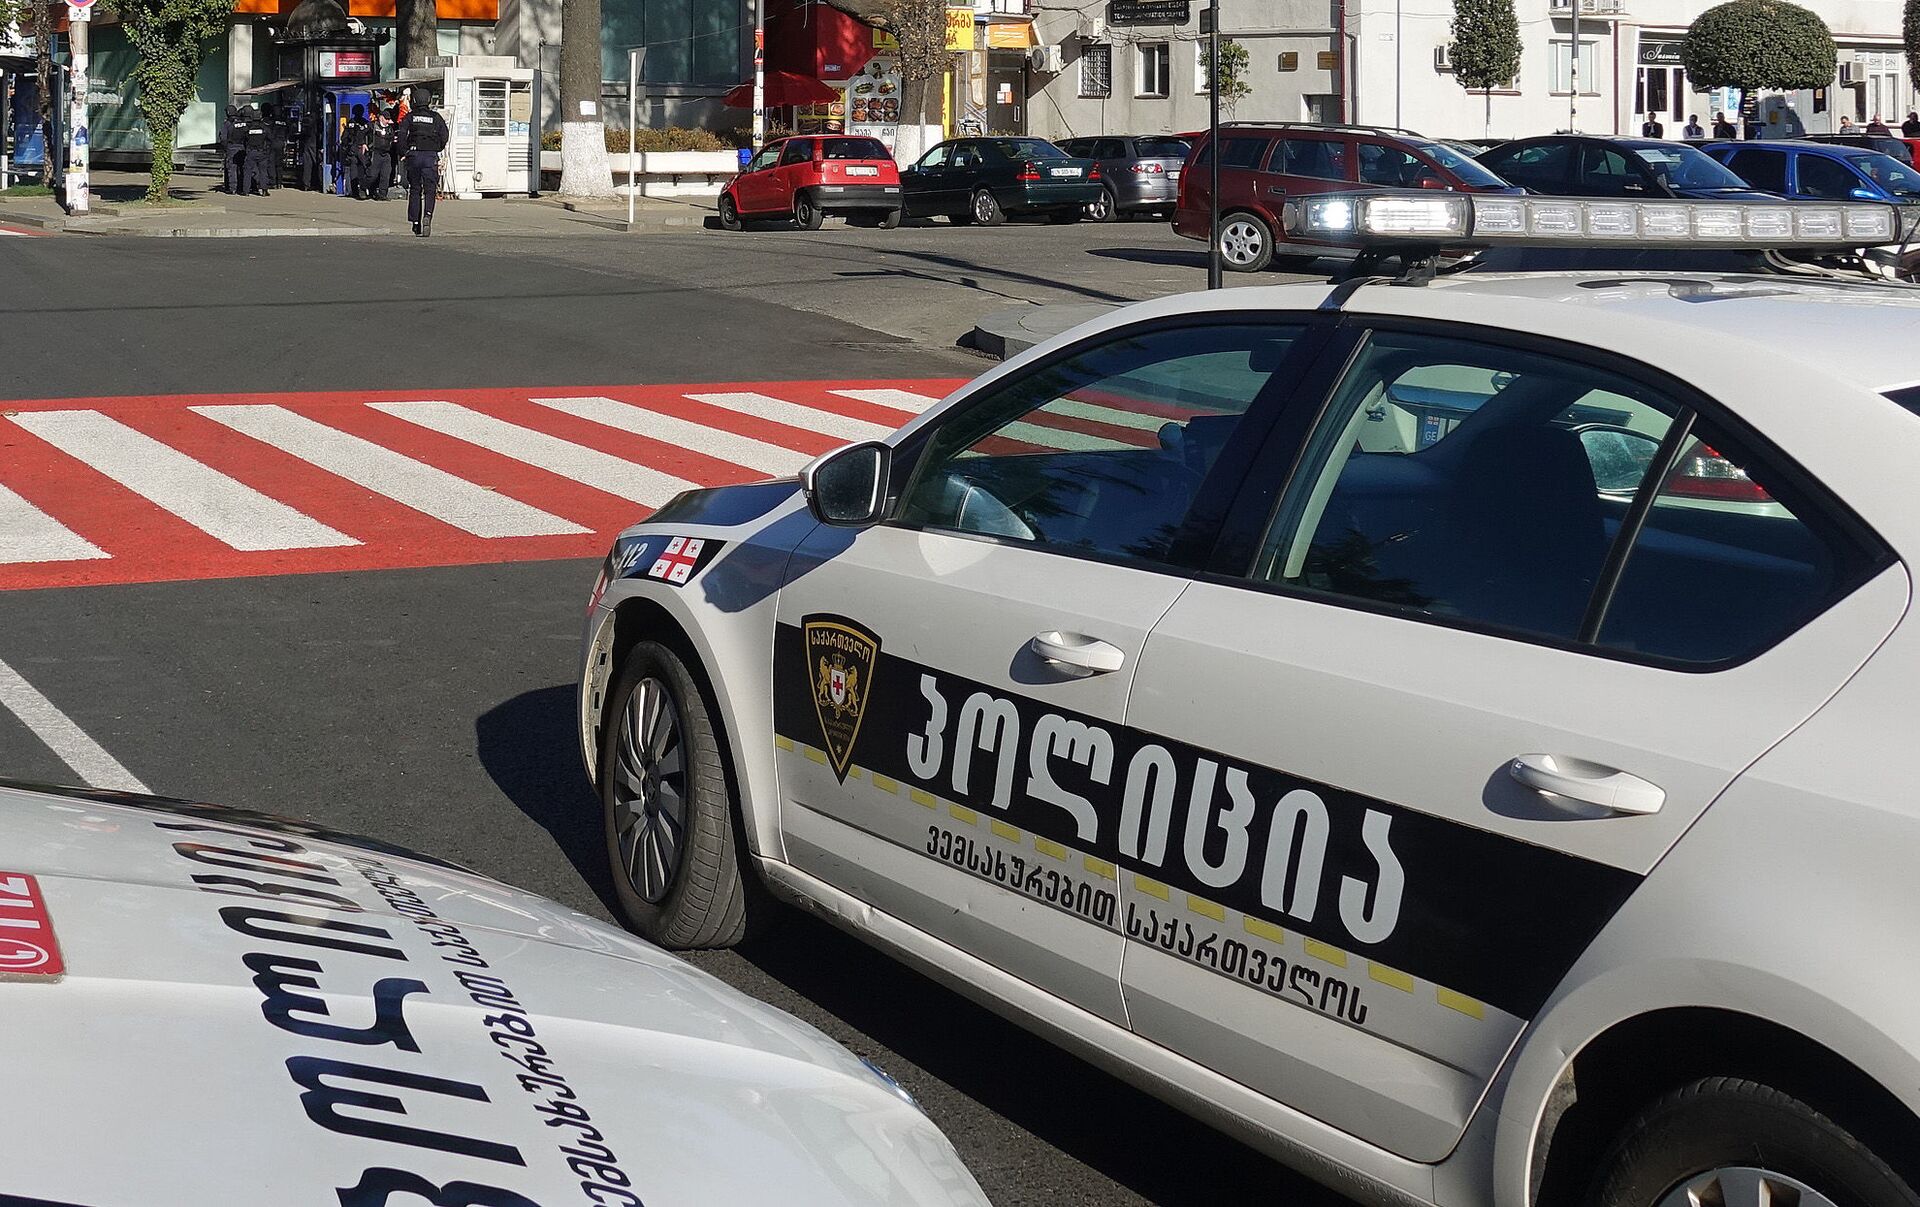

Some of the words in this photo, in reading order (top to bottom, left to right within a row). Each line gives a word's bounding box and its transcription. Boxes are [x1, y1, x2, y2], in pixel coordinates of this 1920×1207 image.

[1425, 431, 1437, 441] GE
[617, 543, 649, 570] 112
[811, 630, 871, 663] საქართველო
[906, 673, 1405, 945] პოლიცია
[926, 825, 1117, 927] ვემსახურებით
[1126, 902, 1369, 1025] საქართველოს
[452, 970, 645, 1207] ემსახურებით
